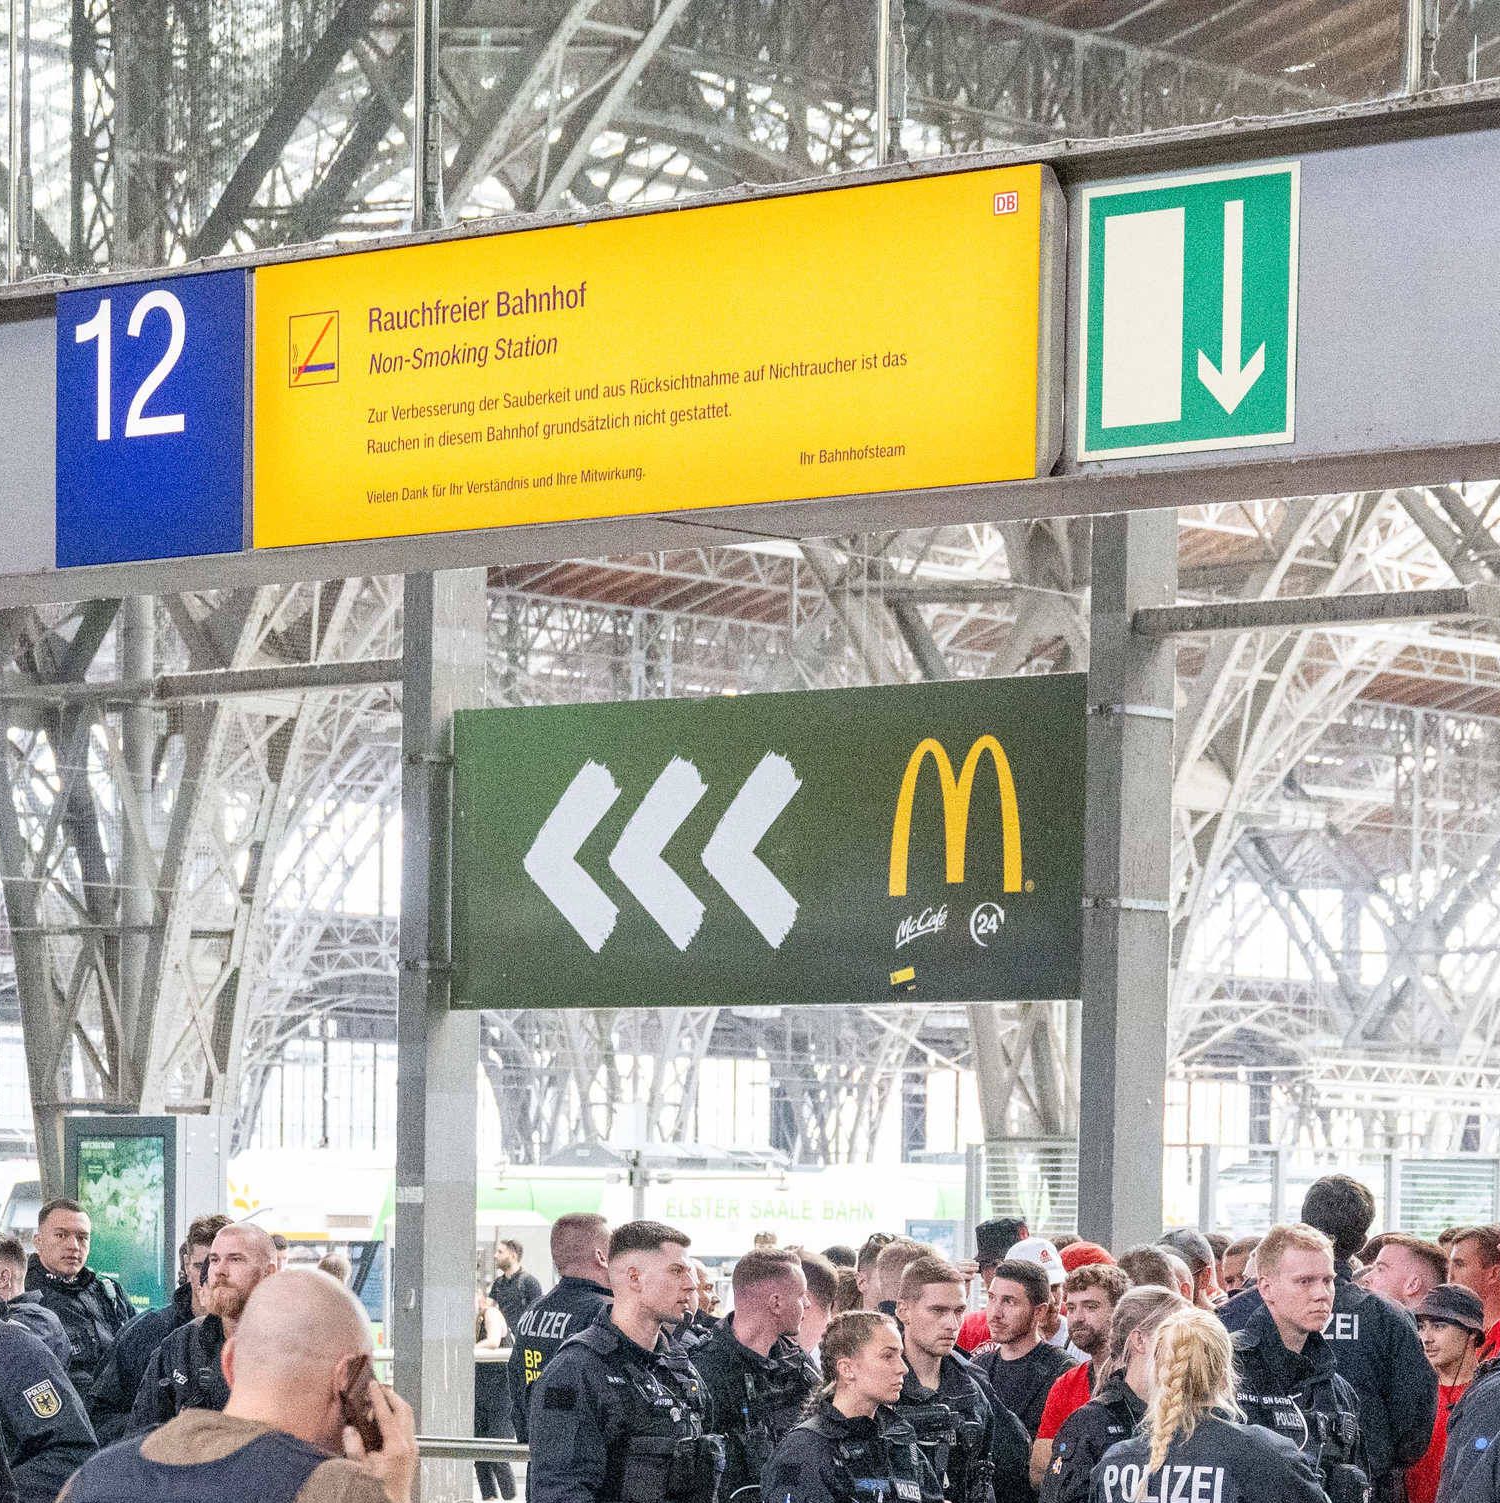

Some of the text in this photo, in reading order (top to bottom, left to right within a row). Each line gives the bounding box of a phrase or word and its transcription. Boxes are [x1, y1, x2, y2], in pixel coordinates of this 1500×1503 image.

[996, 194, 1016, 213] DB
[368, 281, 587, 333] Rauchfreier Bahnhof
[75, 289, 186, 441] 12
[368, 334, 558, 375] Non-Smoking Station
[367, 351, 908, 424] Zur Verbesserung der Sauberkeit und aus Rücksichtnahme auf Nichtraucher ist das
[367, 402, 732, 455] Rauchen in diesem Bahnhof grundsätzlich nicht gestattet.
[800, 443, 906, 465] Ihr Bahnhofsteam
[366, 465, 646, 504] Vielen Dank für Ihr Verständnis und Ihre Mitwirkung.
[896, 904, 948, 946] McCafé
[977, 914, 999, 934] 24
[666, 1198, 876, 1221] ELSTER SAALE BAHN
[524, 1349, 542, 1368] BP
